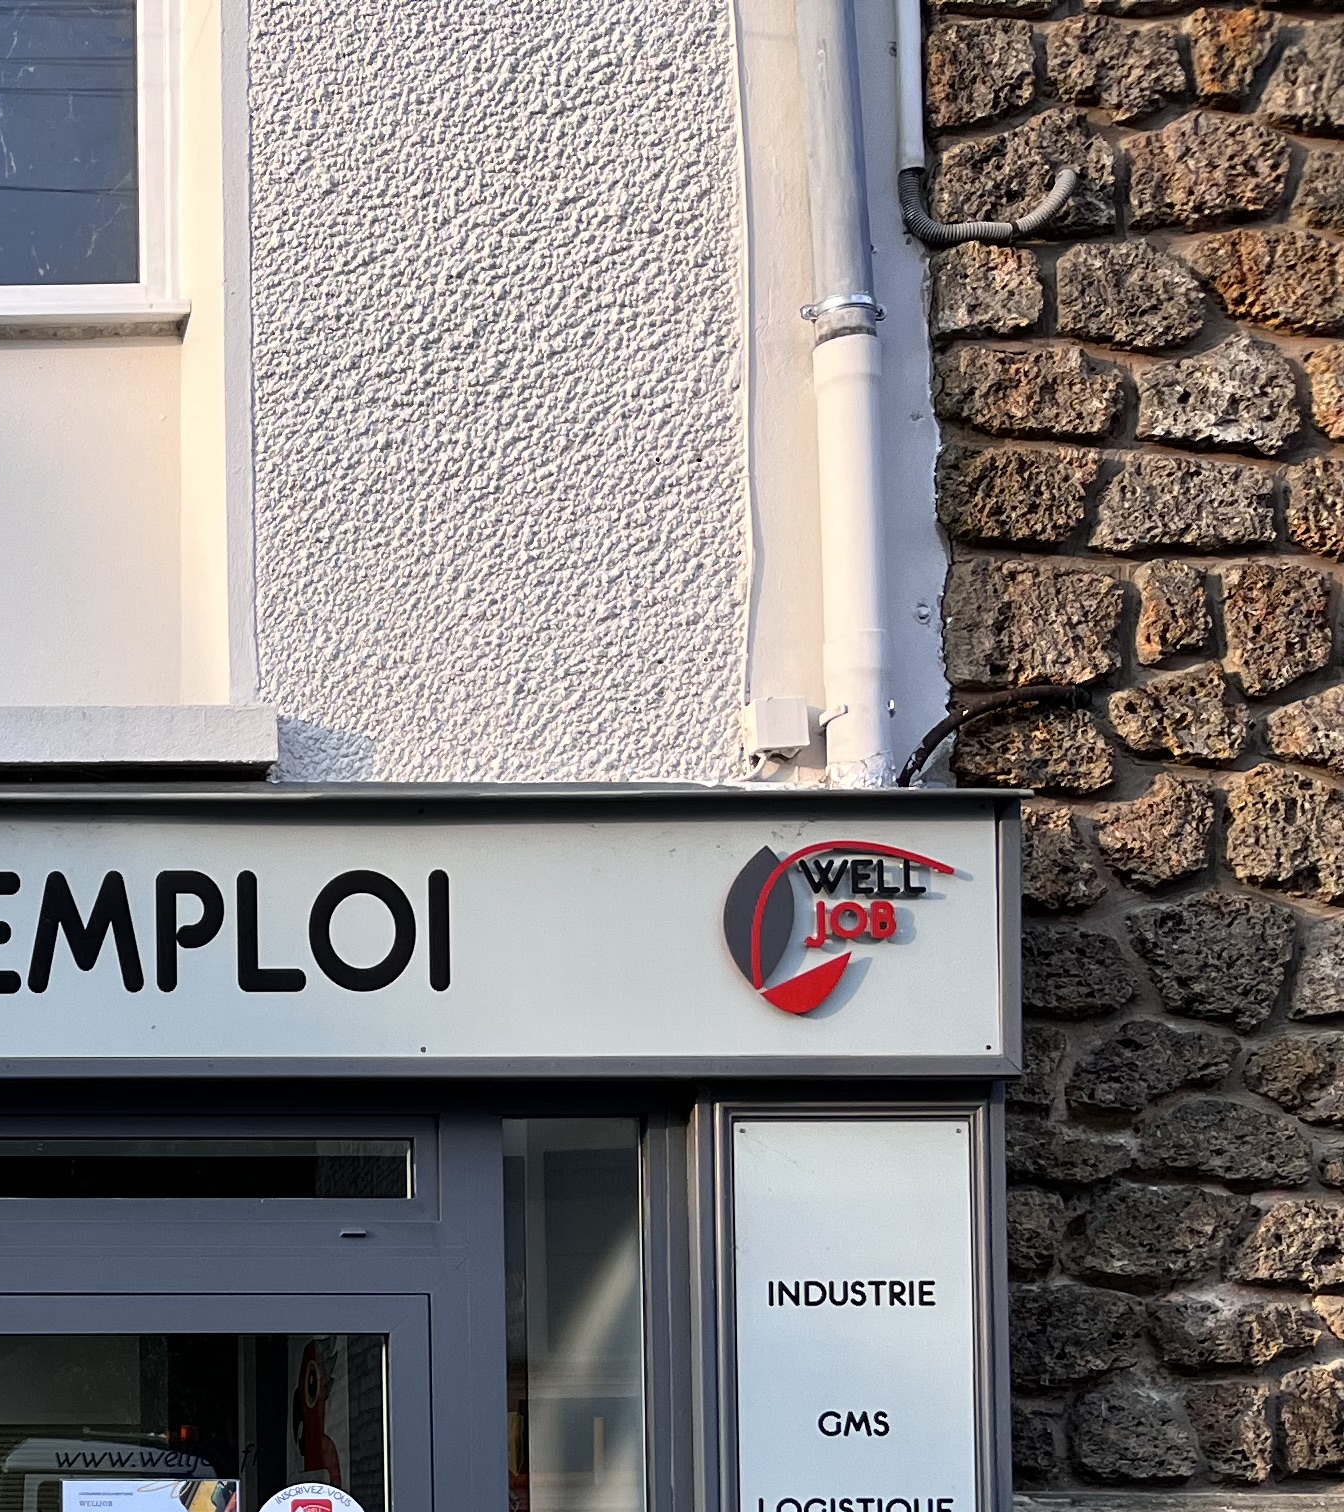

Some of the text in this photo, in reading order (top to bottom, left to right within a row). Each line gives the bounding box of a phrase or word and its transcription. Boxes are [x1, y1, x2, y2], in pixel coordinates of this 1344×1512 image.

[798, 859, 927, 896] WELL
[804, 900, 897, 948] JOB
[767, 1280, 937, 1307] INDUSTRIE
[817, 1411, 891, 1437] GMS
